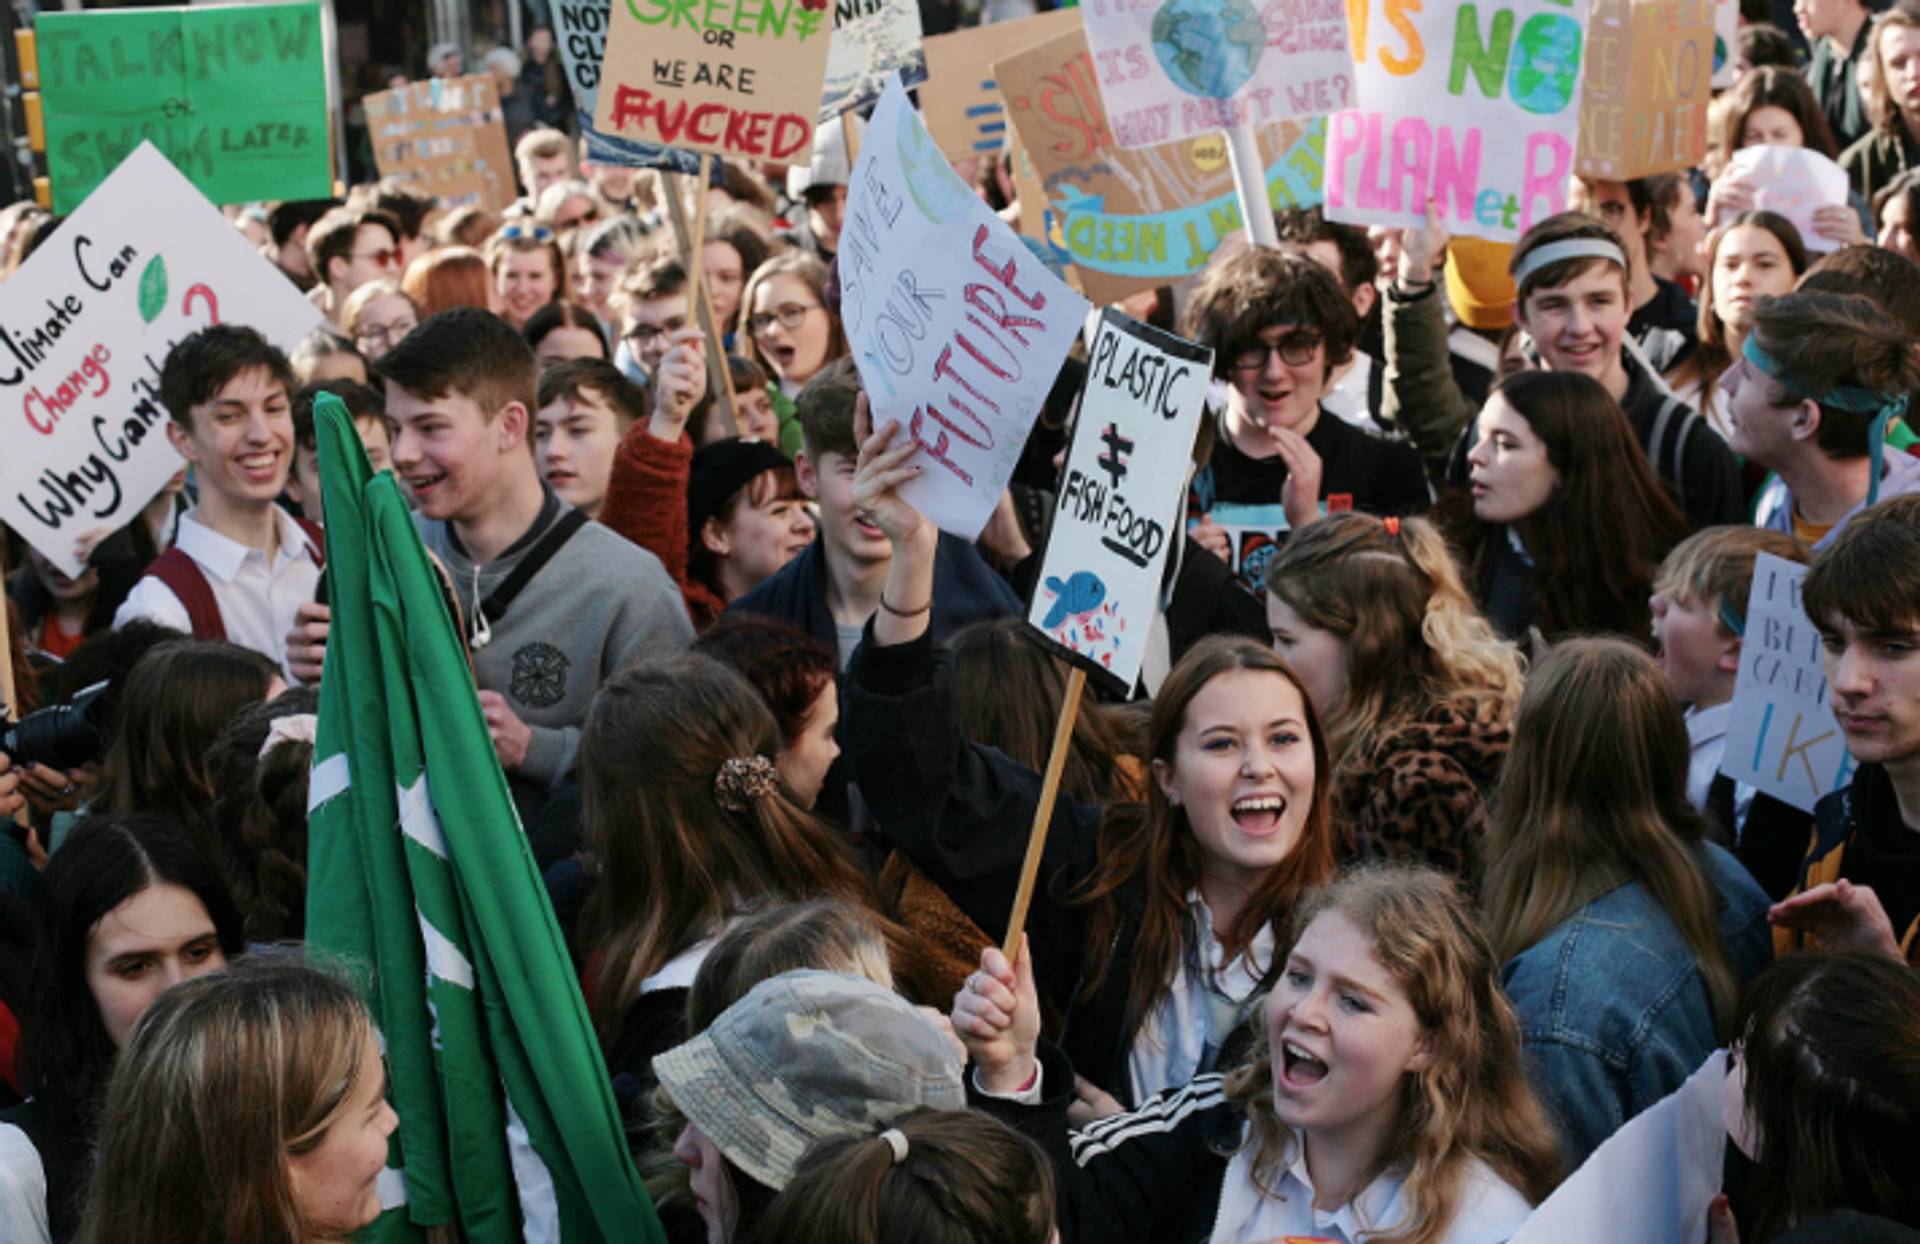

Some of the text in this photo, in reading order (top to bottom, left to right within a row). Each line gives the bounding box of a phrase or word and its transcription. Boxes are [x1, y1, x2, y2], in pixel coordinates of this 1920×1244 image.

[193, 13, 312, 80] NOW
[653, 59, 756, 94] WE ARE
[703, 29, 735, 49] OR
[1448, 3, 1582, 115] NO
[611, 83, 811, 160] FUCKED
[74, 234, 137, 292] Can
[1069, 216, 1168, 264] NEED
[910, 223, 1047, 487] FUTURE
[1092, 331, 1189, 420] PLASTIC
[17, 453, 122, 528] Why
[1061, 470, 1164, 558] FISH FOOD
